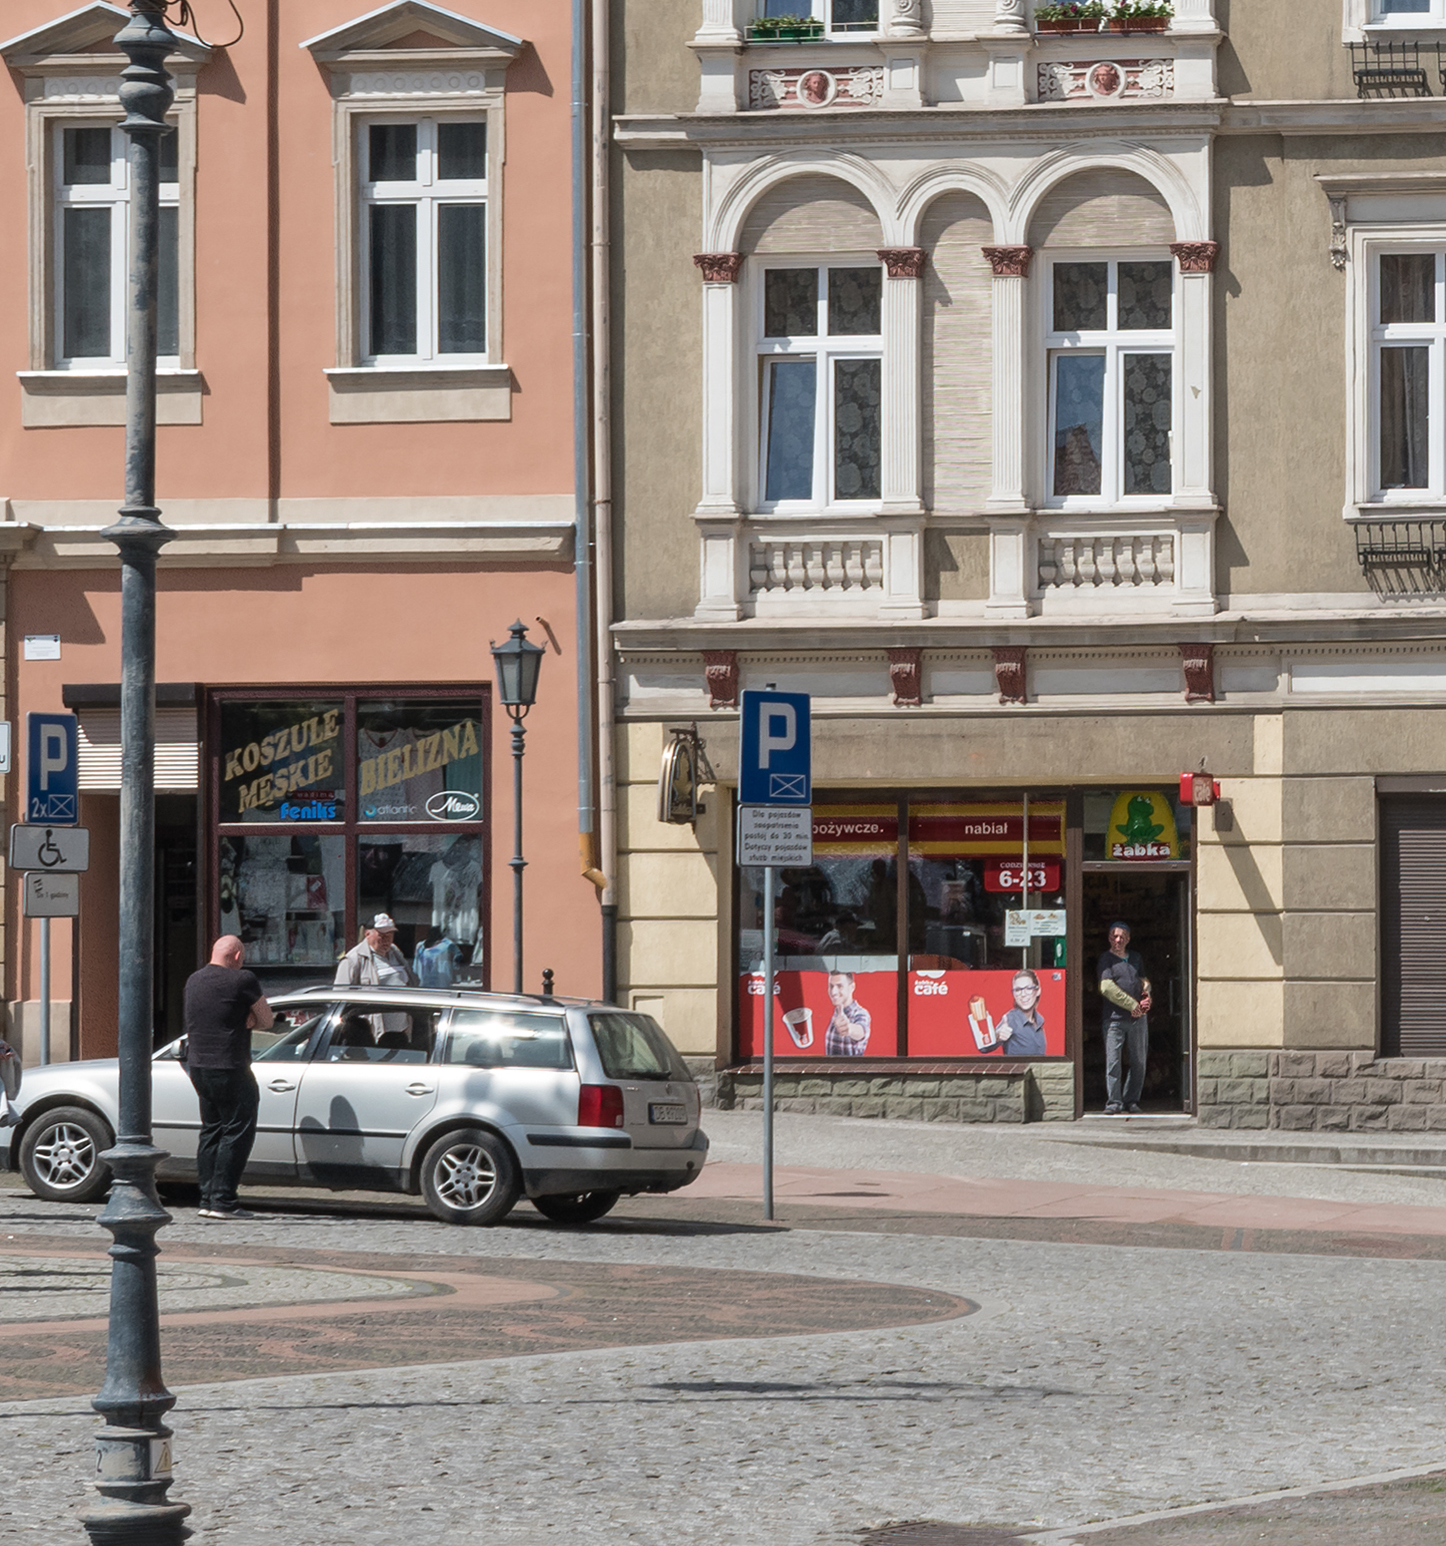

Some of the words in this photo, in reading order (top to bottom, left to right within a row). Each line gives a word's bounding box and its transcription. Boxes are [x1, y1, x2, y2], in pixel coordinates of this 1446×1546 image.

[758, 701, 797, 769] P
[224, 708, 340, 782] KOSZULE
[40, 723, 68, 791] P
[359, 721, 479, 796] BIELIZNA
[238, 749, 333, 813] MĘSKIE
[31, 796, 48, 818] 2x
[280, 800, 336, 819] feniks
[376, 804, 417, 815] atlantic
[752, 810, 765, 818] Dla
[964, 822, 1009, 835] nabiał
[1112, 842, 1171, 857] żabka
[999, 870, 1047, 888] 6-23
[747, 981, 781, 995] caé
[914, 981, 949, 996] café
